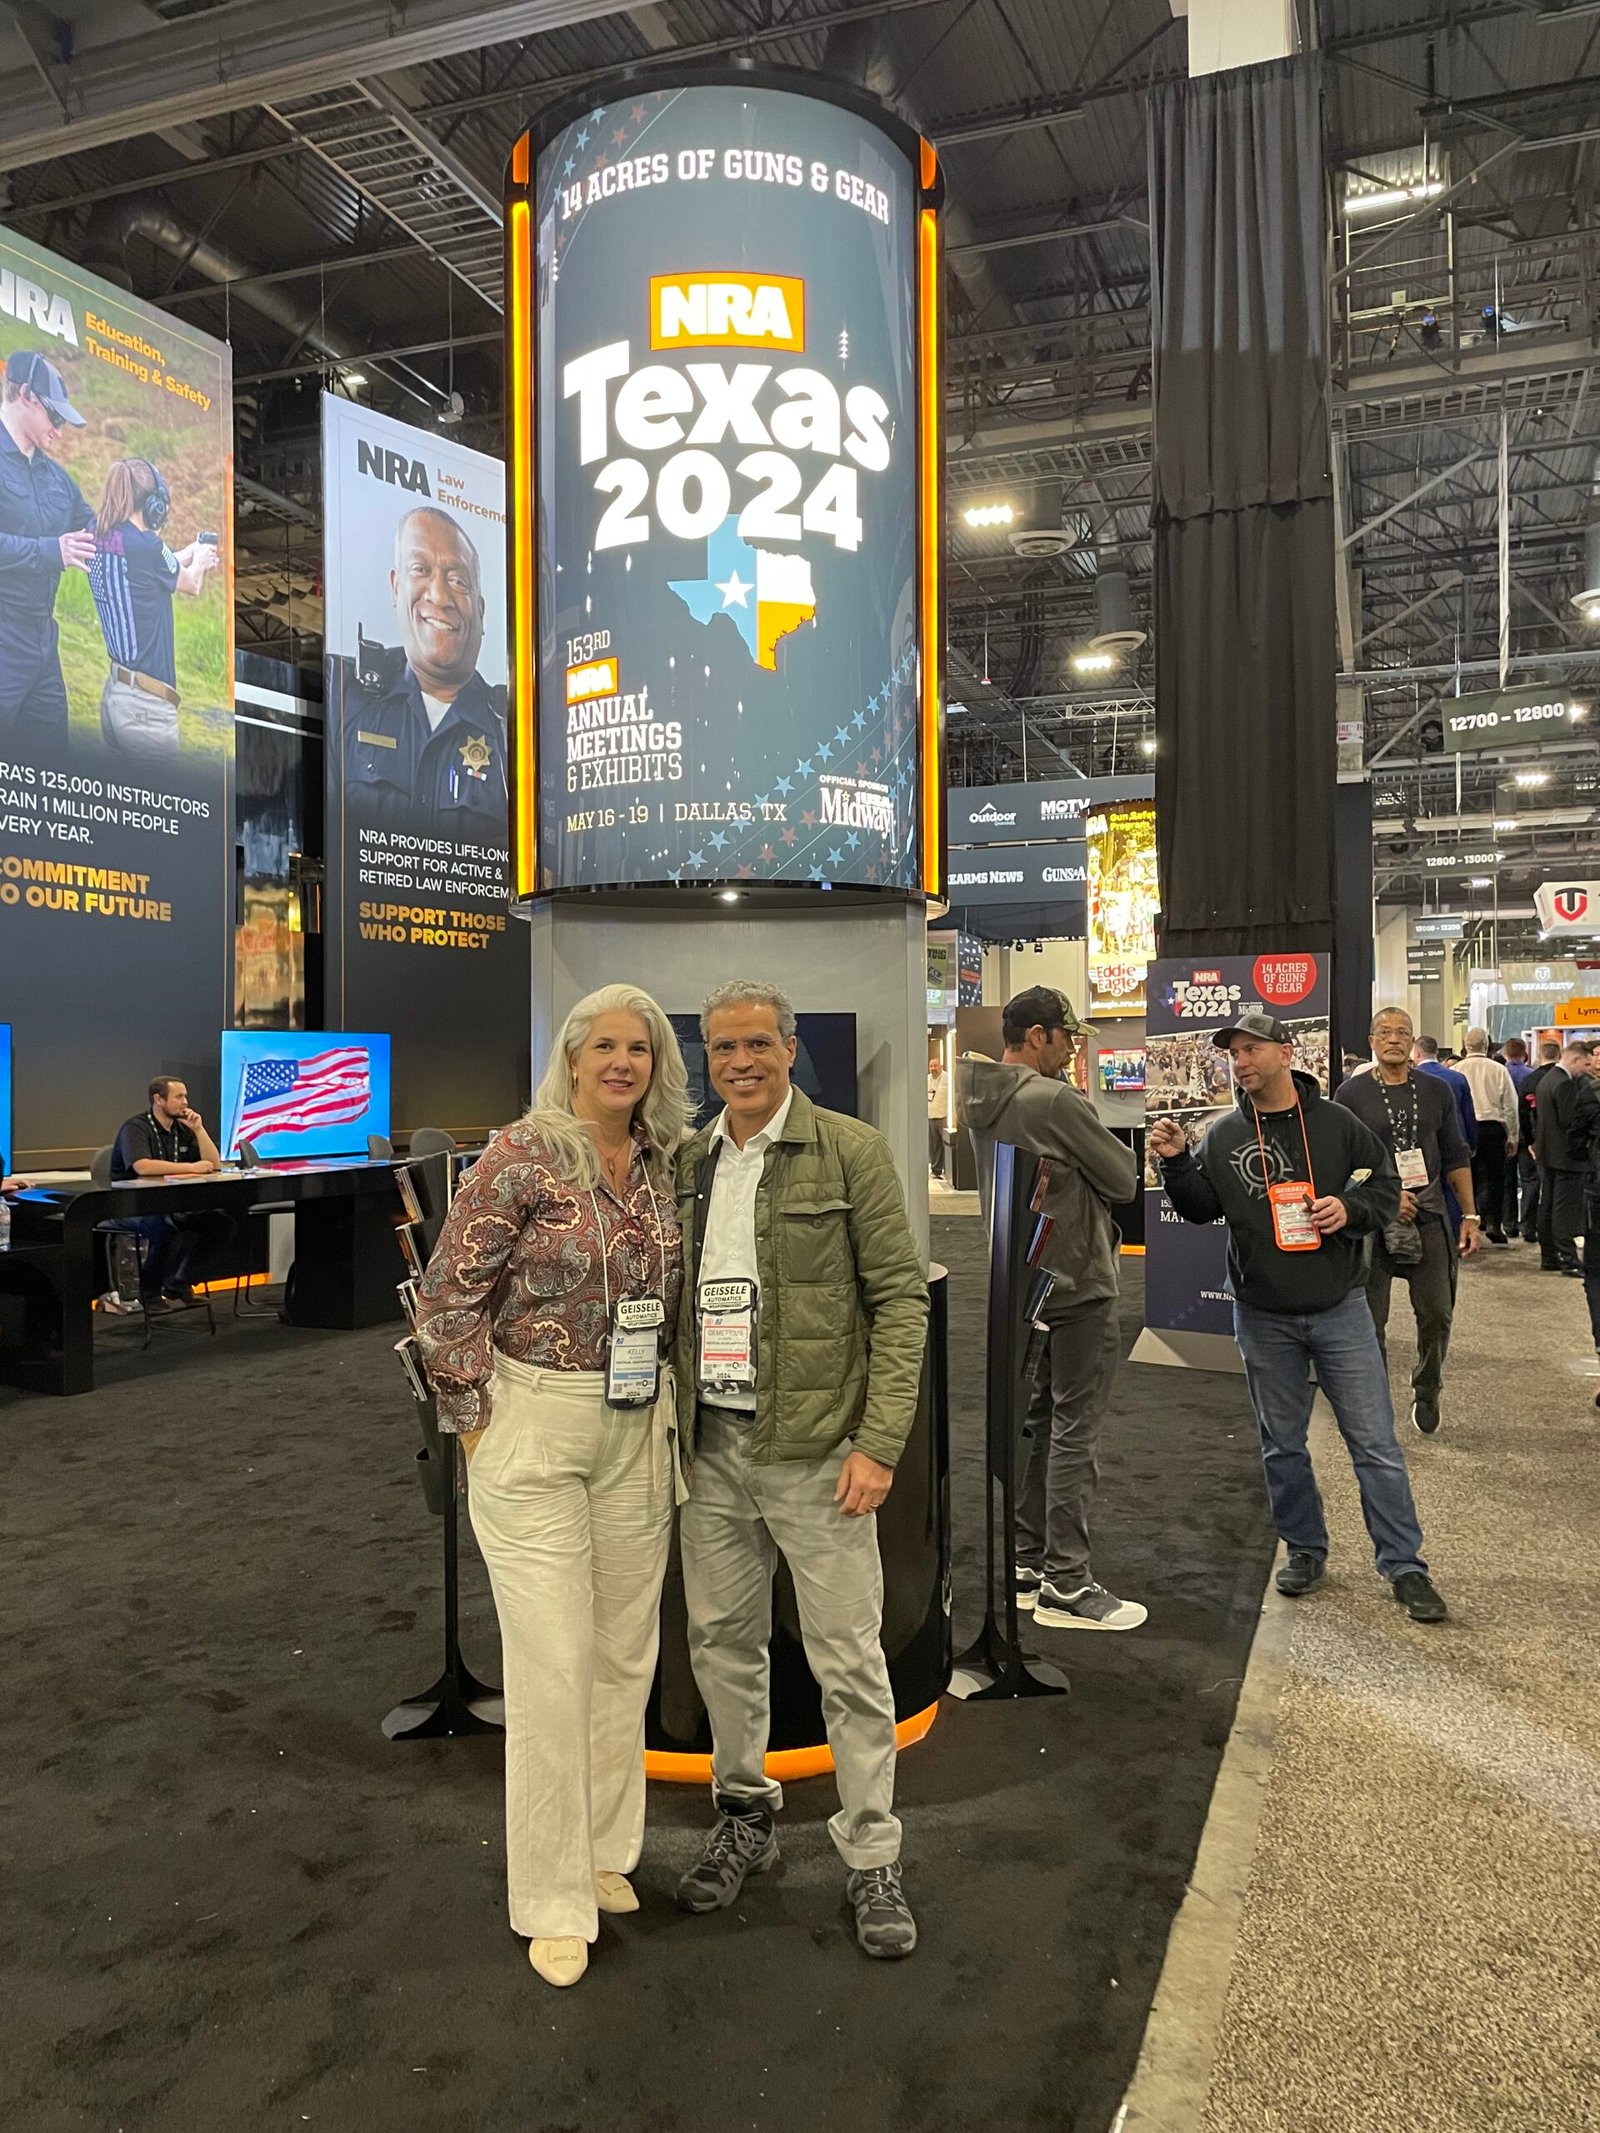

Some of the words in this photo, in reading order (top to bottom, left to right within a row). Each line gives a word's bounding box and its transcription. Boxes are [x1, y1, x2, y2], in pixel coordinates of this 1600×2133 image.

[562, 181, 583, 220] 14
[586, 153, 668, 205] ACRES
[678, 149, 716, 180] OF
[724, 149, 803, 187] GUNS
[811, 162, 829, 193] &
[836, 169, 890, 225] GEAR
[660, 282, 793, 340] NRA
[86, 311, 166, 367] Education,
[85, 336, 150, 384] Training
[151, 369, 162, 387] &
[166, 375, 212, 412] Safety
[563, 340, 891, 472] Texas
[358, 438, 432, 498] NRA
[437, 468, 465, 490] Law
[594, 449, 863, 552] 2024
[566, 630, 610, 667] 153RD
[566, 692, 654, 734] ANNUAL
[1450, 712, 1498, 732] 12700
[1514, 702, 1564, 722] 12800
[566, 721, 682, 764] MEETINGS
[568, 766, 578, 792] &
[581, 753, 682, 790] EXHIBITS
[819, 774, 857, 787] OFFICIAL
[40, 770, 102, 796] 125,000
[107, 784, 210, 818] INSTRUCTORS
[42, 796, 48, 812] 1
[53, 798, 118, 824] MILLION
[122, 810, 179, 835] PEOPLE
[566, 811, 596, 832] MAY
[598, 808, 614, 827] 16
[628, 805, 648, 824] 19
[675, 802, 756, 822] DALLAS,
[762, 804, 788, 821] TX
[969, 812, 1017, 824] Outdoor
[1110, 814, 1128, 822] Gun
[1110, 821, 1150, 832] Program
[46, 821, 94, 844] YEAR.
[360, 828, 388, 846] NRA
[390, 834, 452, 854] PROVIDES
[360, 849, 420, 870] SUPPORT
[423, 859, 448, 874] FOR
[450, 862, 492, 880] ACTIVE
[494, 868, 502, 880] &
[1426, 856, 1456, 866] 12800
[1464, 854, 1494, 864] 13000
[0, 856, 150, 895] OMMITMENT
[360, 869, 413, 888] RETIRED
[416, 876, 442, 892] LAW
[446, 880, 509, 899] ENFORCEM
[989, 870, 1024, 884] NEWS
[26, 886, 80, 912] OUR
[84, 892, 172, 922] FUTURE
[360, 902, 446, 926] SUPPORT
[450, 911, 506, 932] THOSE
[359, 922, 406, 942] WHO
[410, 927, 490, 949] PROTECT
[1097, 963, 1136, 978] Eddie
[1194, 972, 1218, 982] NRA
[1262, 964, 1272, 973] 14
[1276, 962, 1308, 973] ACRES
[1264, 974, 1276, 984] OF
[1278, 972, 1306, 982] GUNS
[1098, 978, 1136, 995] Eagle
[1172, 981, 1242, 1002] Texas
[1266, 984, 1274, 994] &
[1276, 983, 1303, 993] GEAR
[1180, 1000, 1232, 1018] 2024
[1274, 1186, 1308, 1194] GEISSELE
[704, 1285, 748, 1296] GEISSELE
[620, 1302, 660, 1314] GEISSELE
